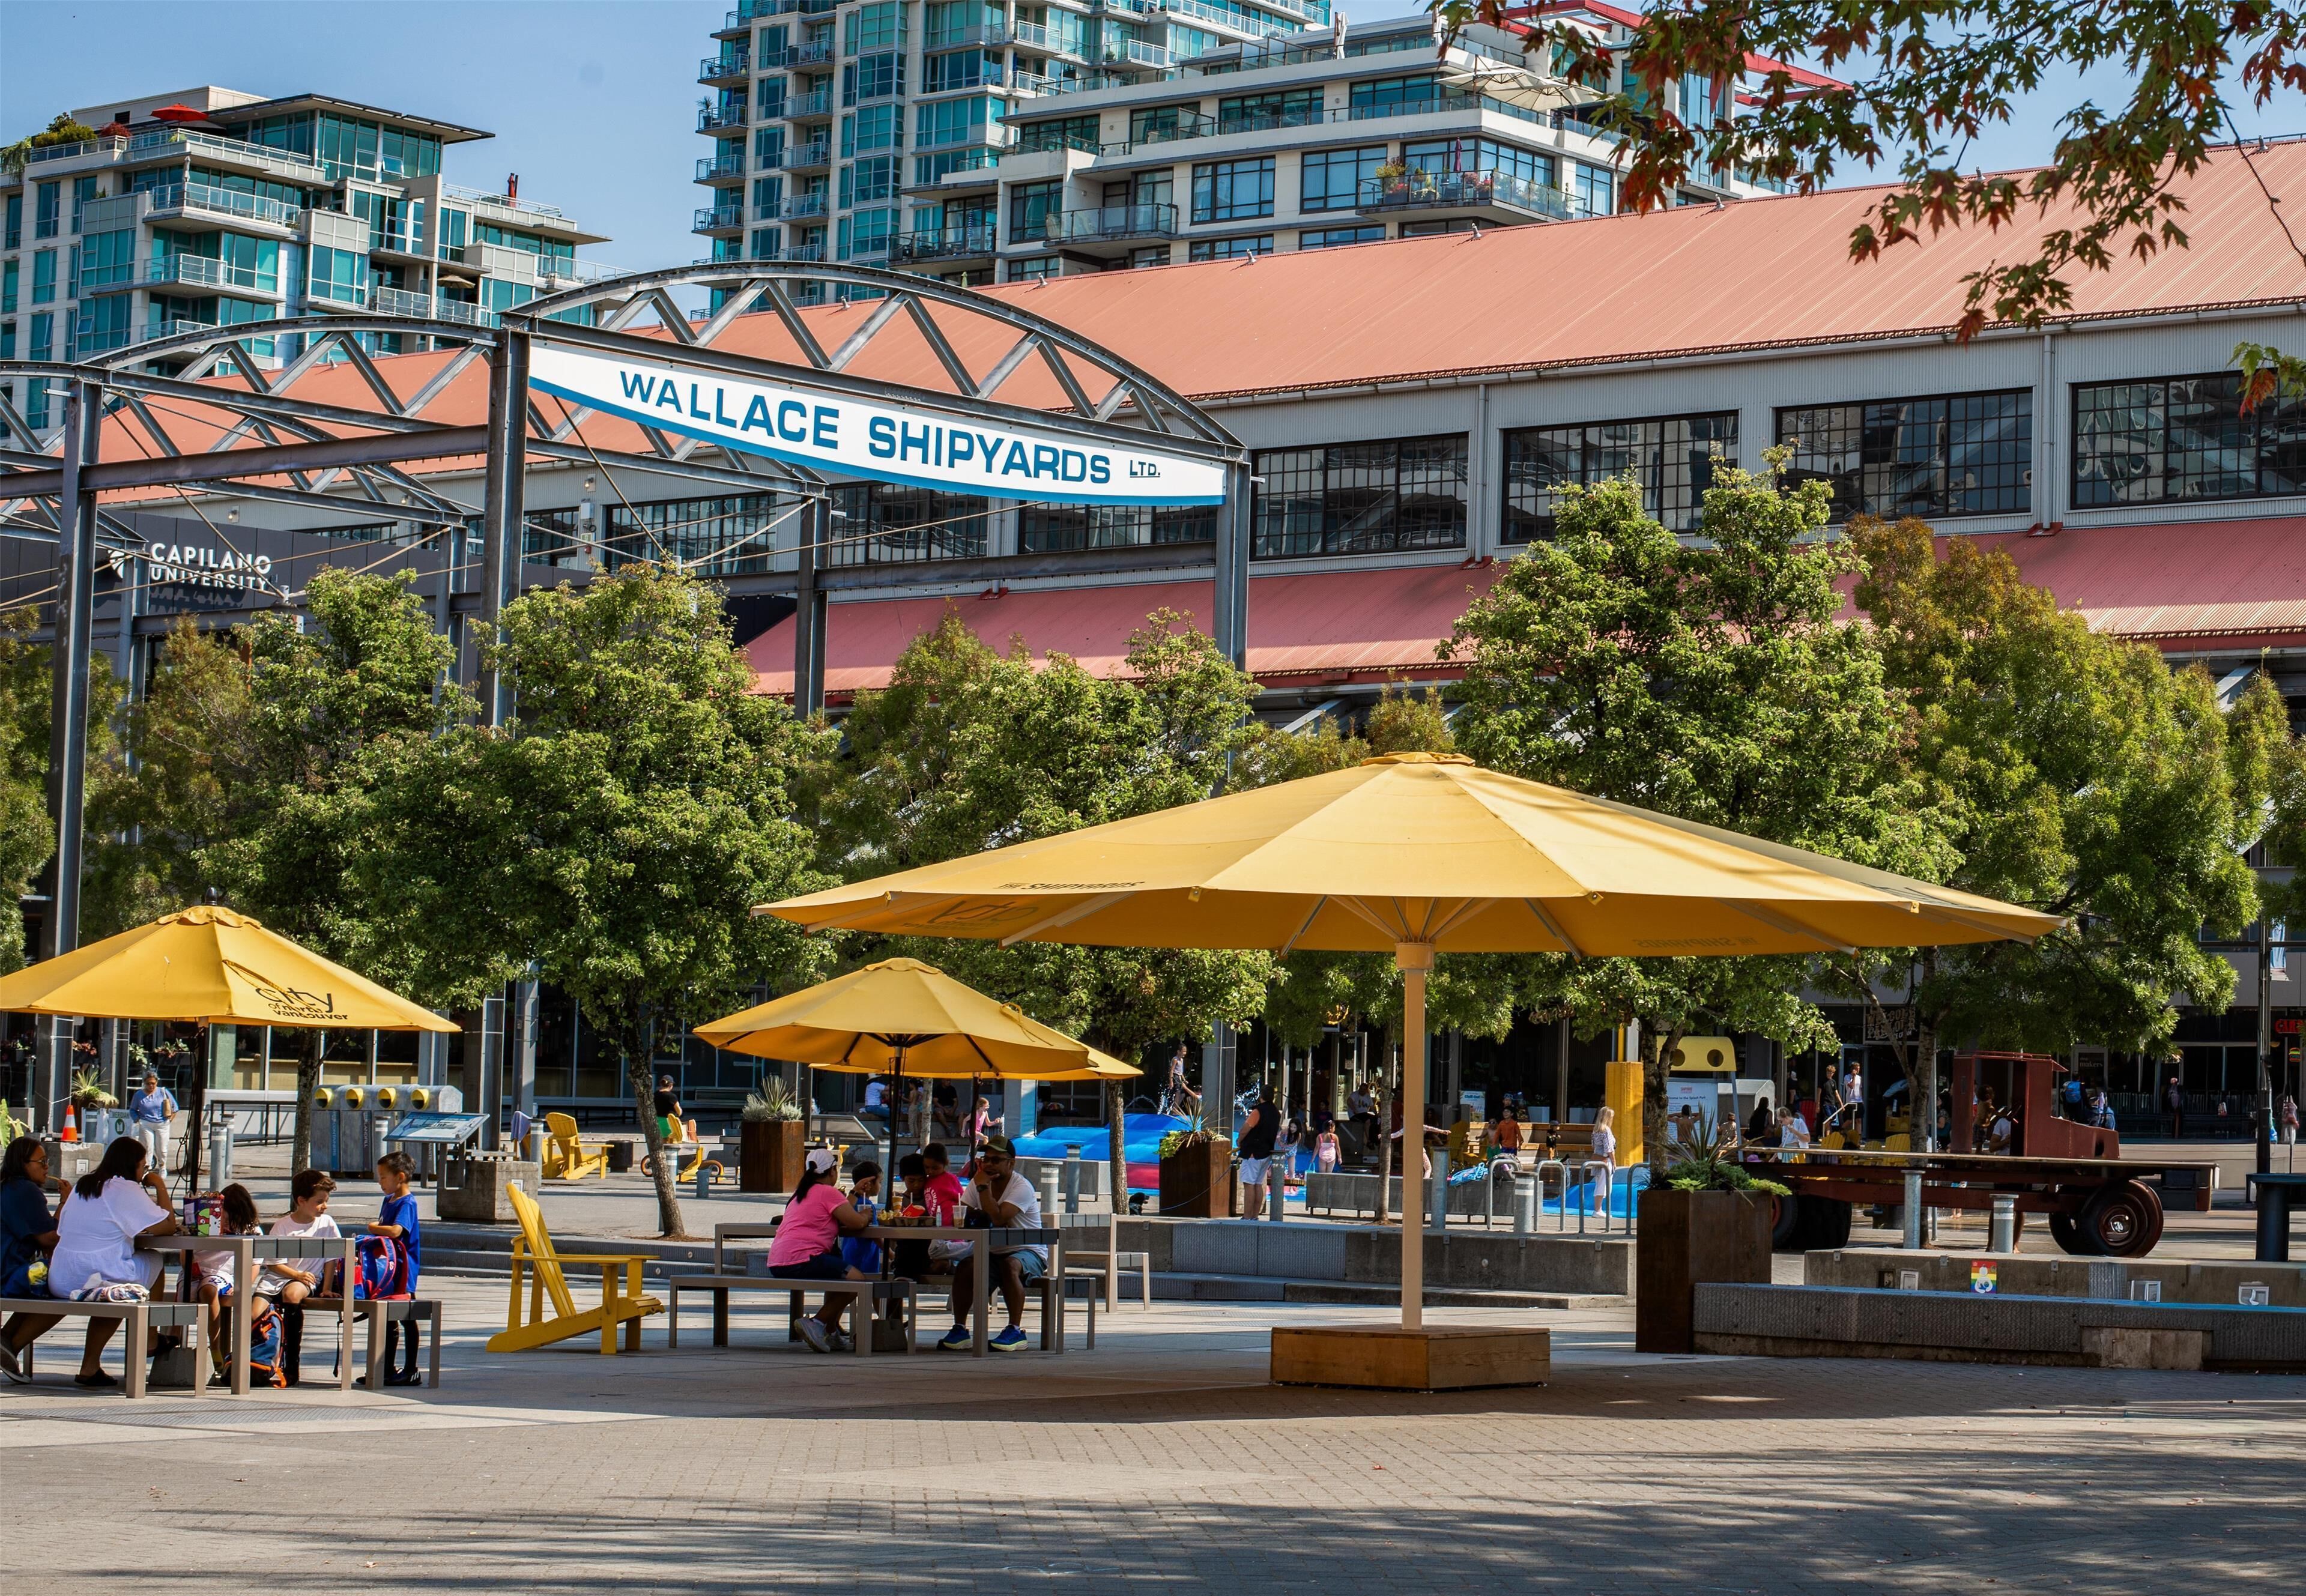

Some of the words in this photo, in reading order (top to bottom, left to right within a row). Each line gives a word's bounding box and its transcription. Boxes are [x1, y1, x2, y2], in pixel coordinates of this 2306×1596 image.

[620, 370, 839, 449] WALLACE
[869, 416, 1110, 484] SHIPYARDS
[1130, 460, 1160, 476] LTD.
[151, 543, 271, 574] CAPILANO
[151, 567, 268, 591] UNIVERSITY
[273, 1009, 348, 1020] vancouver
